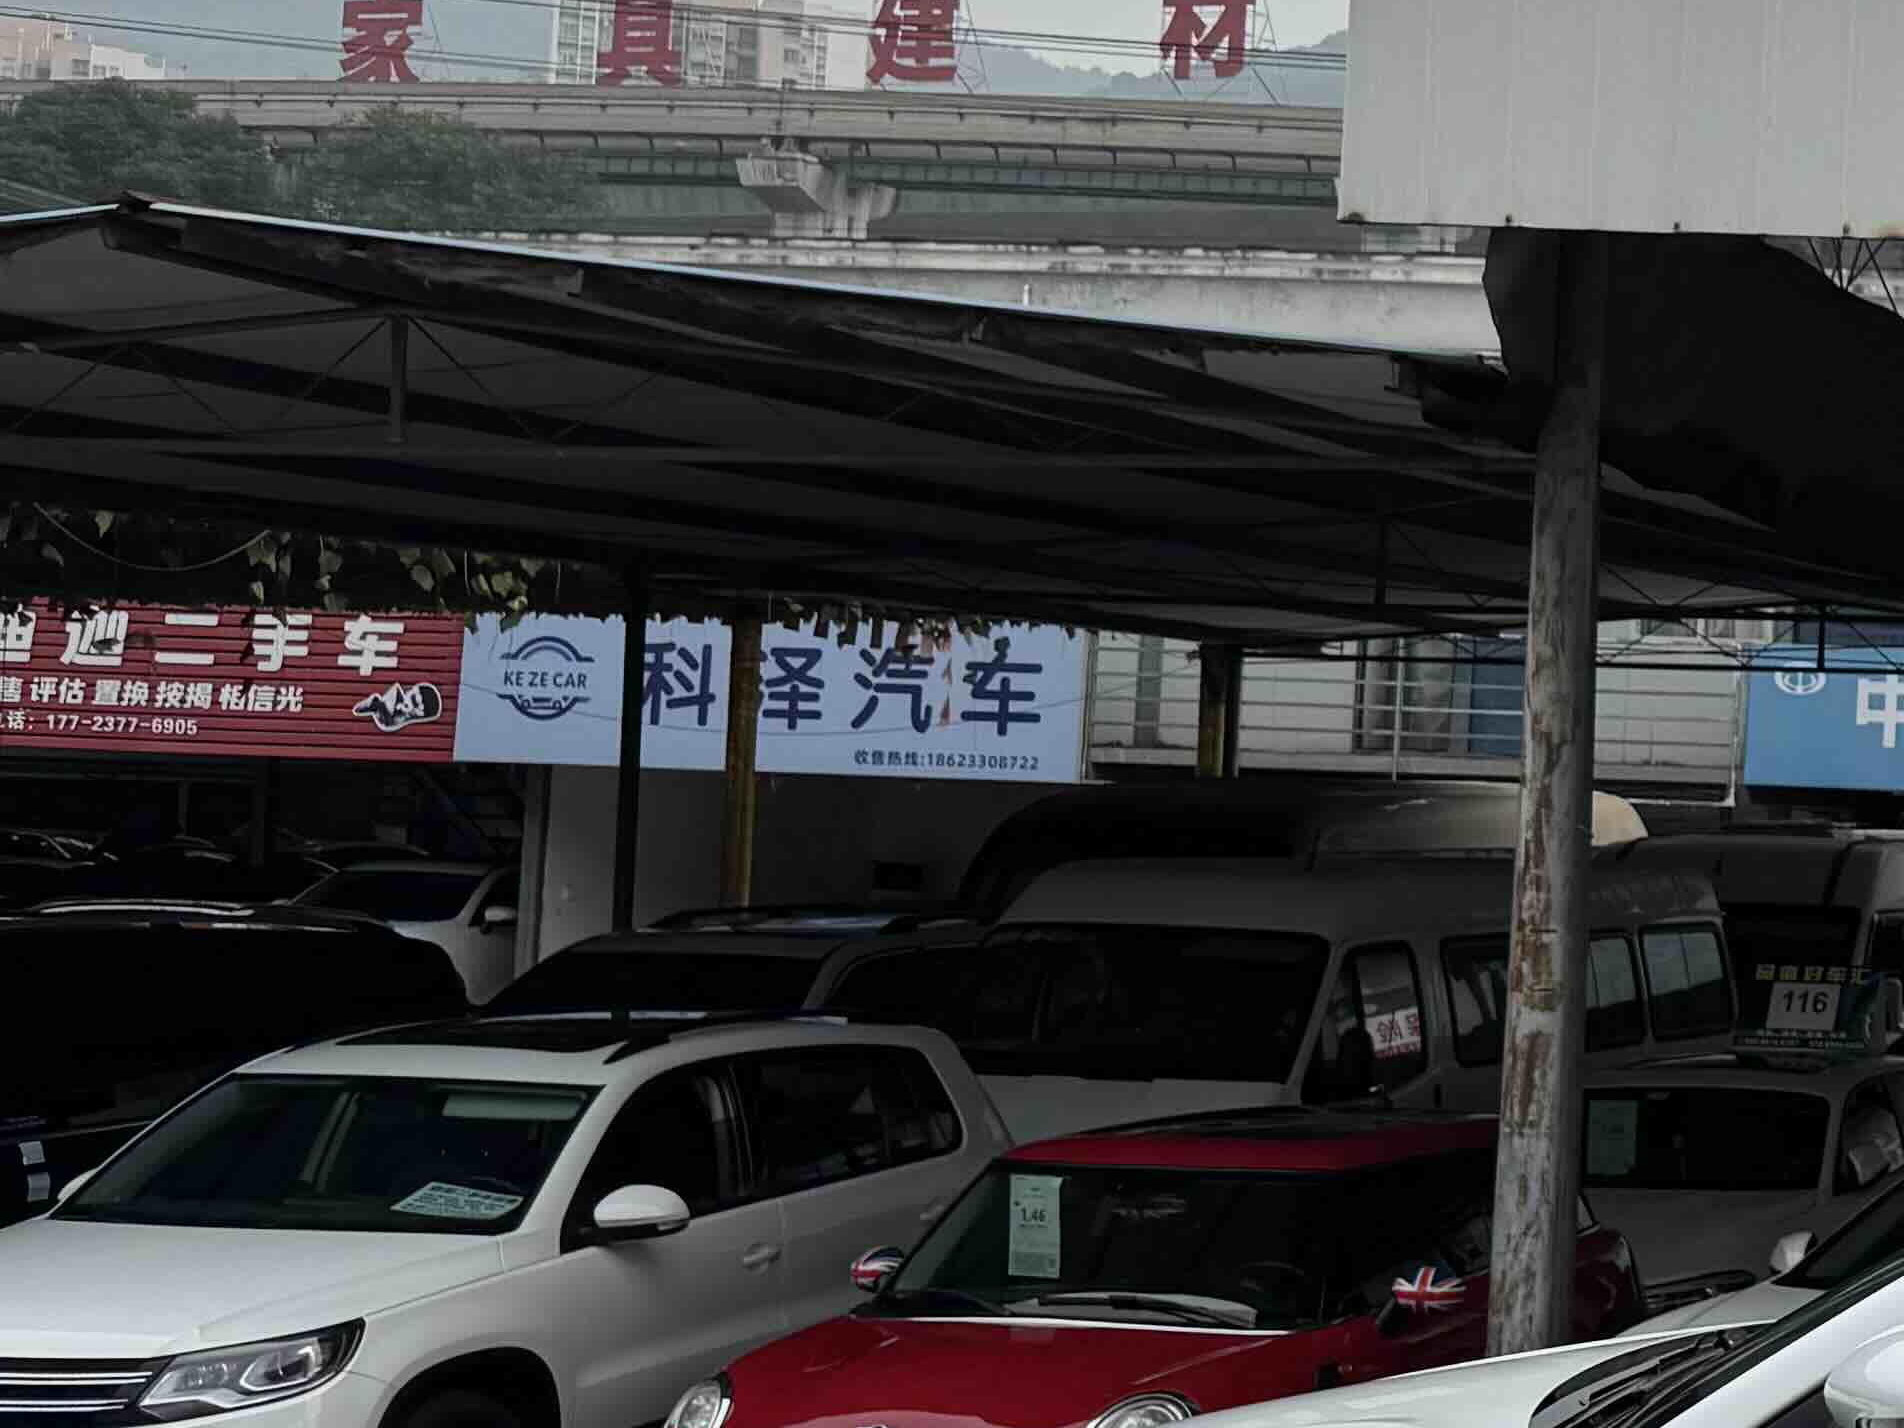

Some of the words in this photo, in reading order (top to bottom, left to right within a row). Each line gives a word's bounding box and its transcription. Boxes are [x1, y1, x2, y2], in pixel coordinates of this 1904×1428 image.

[504, 670, 523, 689] KE
[527, 670, 550, 690] ZE
[552, 671, 588, 690] CAR
[643, 636, 1043, 736] 科泽汽车
[0, 708, 198, 735] 话：177-2377-6905
[1782, 989, 1828, 1013] 116
